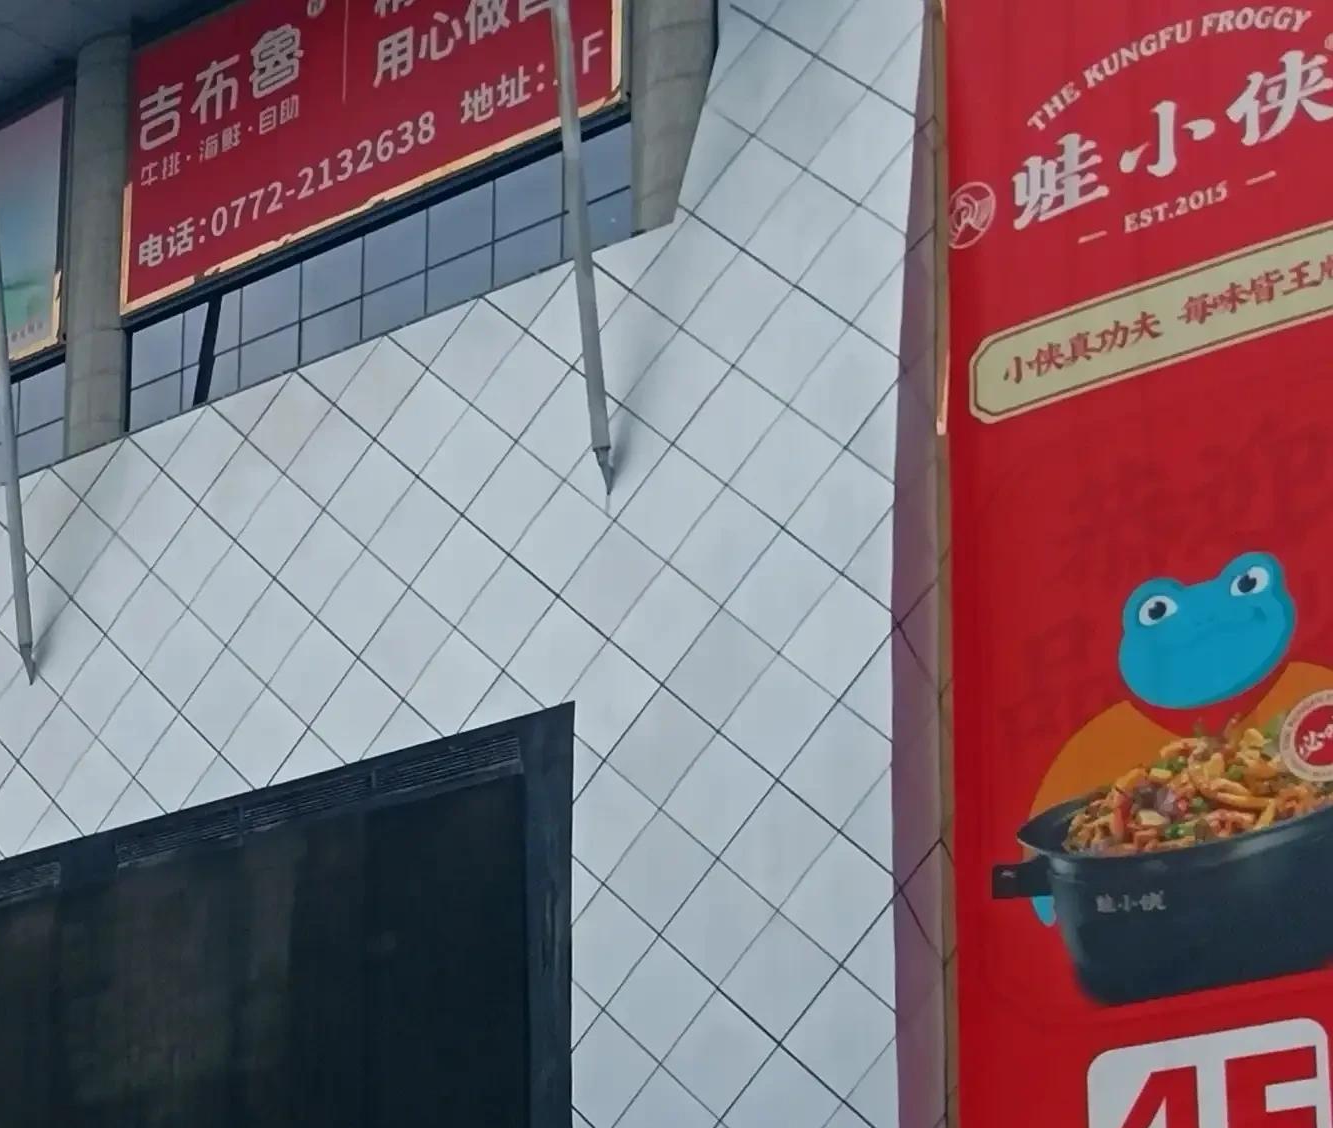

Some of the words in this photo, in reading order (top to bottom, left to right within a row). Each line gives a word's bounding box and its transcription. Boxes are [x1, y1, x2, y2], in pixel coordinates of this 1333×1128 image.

[139, 23, 304, 151] 吉布鲁
[1027, 82, 1081, 132] THE
[1084, 20, 1193, 88] KUNGFU
[1201, 6, 1313, 38] FROGGY
[137, 111, 436, 269] 电话：0772-2132638
[1011, 49, 1333, 231] 蛙小侠
[1124, 181, 1228, 234] EST.2015
[1002, 311, 1162, 384] 小侠真功夫
